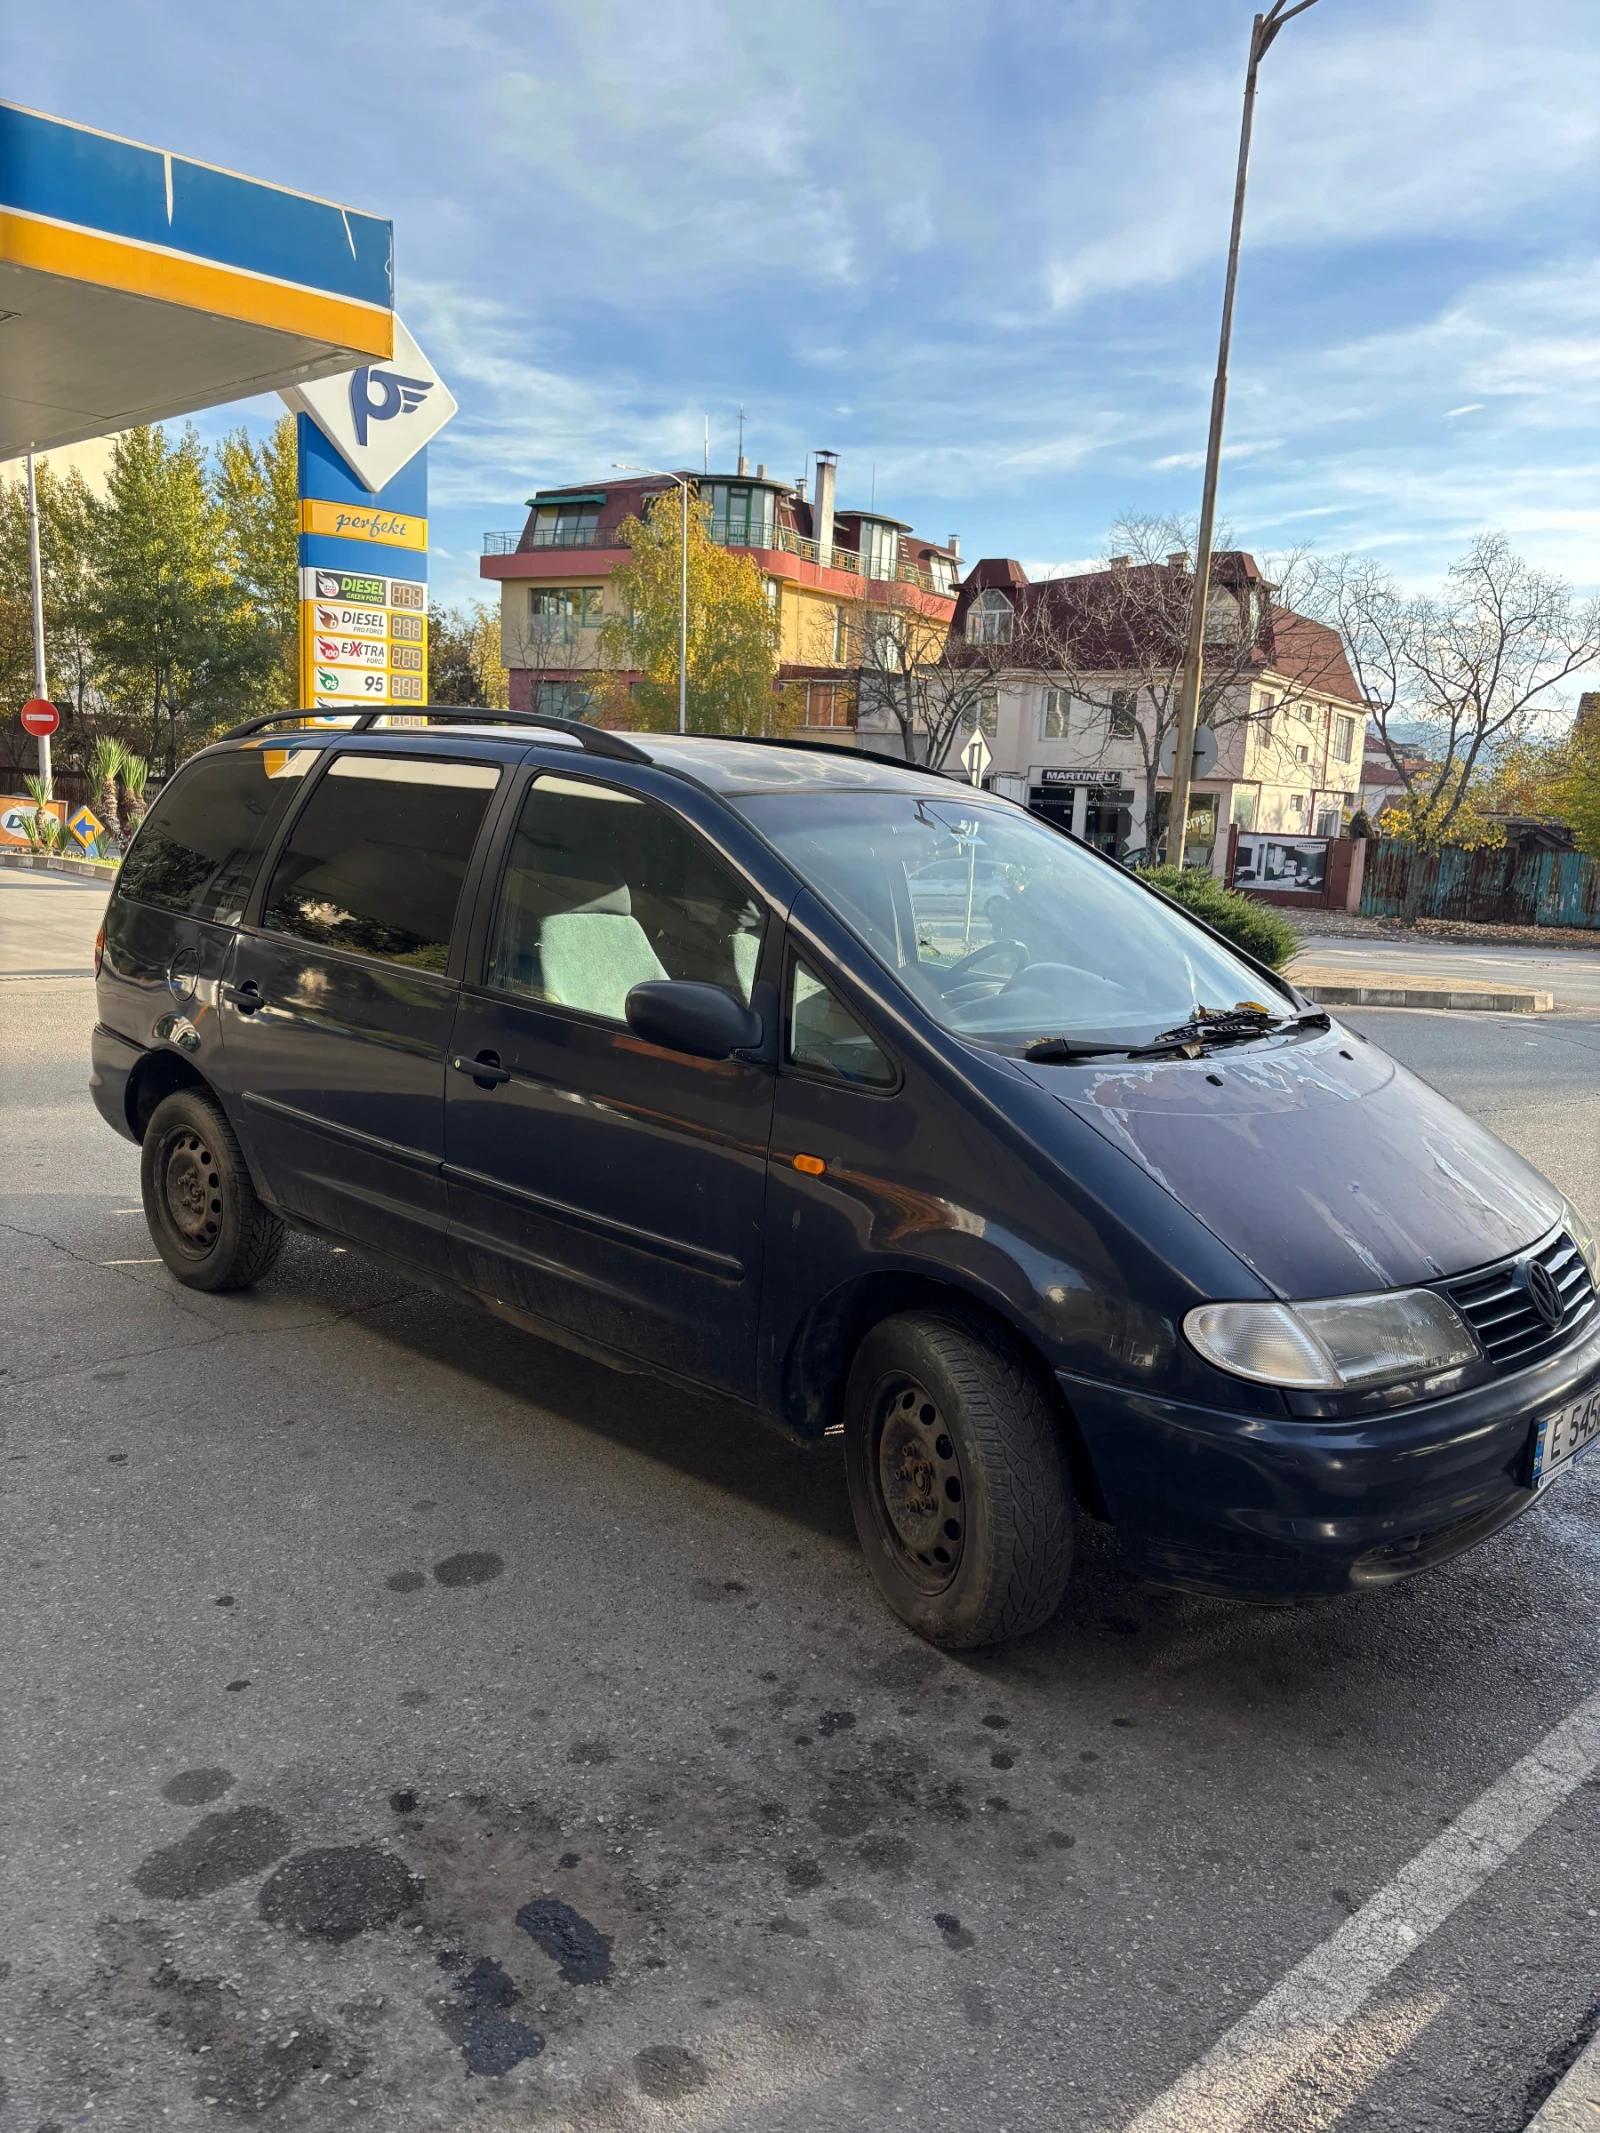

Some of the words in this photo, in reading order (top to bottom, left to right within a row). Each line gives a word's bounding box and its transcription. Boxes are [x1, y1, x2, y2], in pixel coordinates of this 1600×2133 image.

[336, 514, 406, 538] perfekt
[341, 577, 385, 596] DIESEL
[346, 593, 365, 601] GREEN
[366, 595, 383, 603] FORCE
[341, 611, 384, 627] DIESEL
[353, 626, 365, 634] PRO
[366, 627, 383, 636] FORCE
[325, 649, 338, 658] 100
[366, 657, 384, 666] FORCE
[325, 680, 338, 689] 95
[364, 675, 384, 692] 95
[1046, 771, 1115, 782] MARTINELI
[1185, 813, 1212, 829] ОГРЕС
[1551, 1414, 1564, 1461] E
[1569, 1393, 1600, 1447] 545
